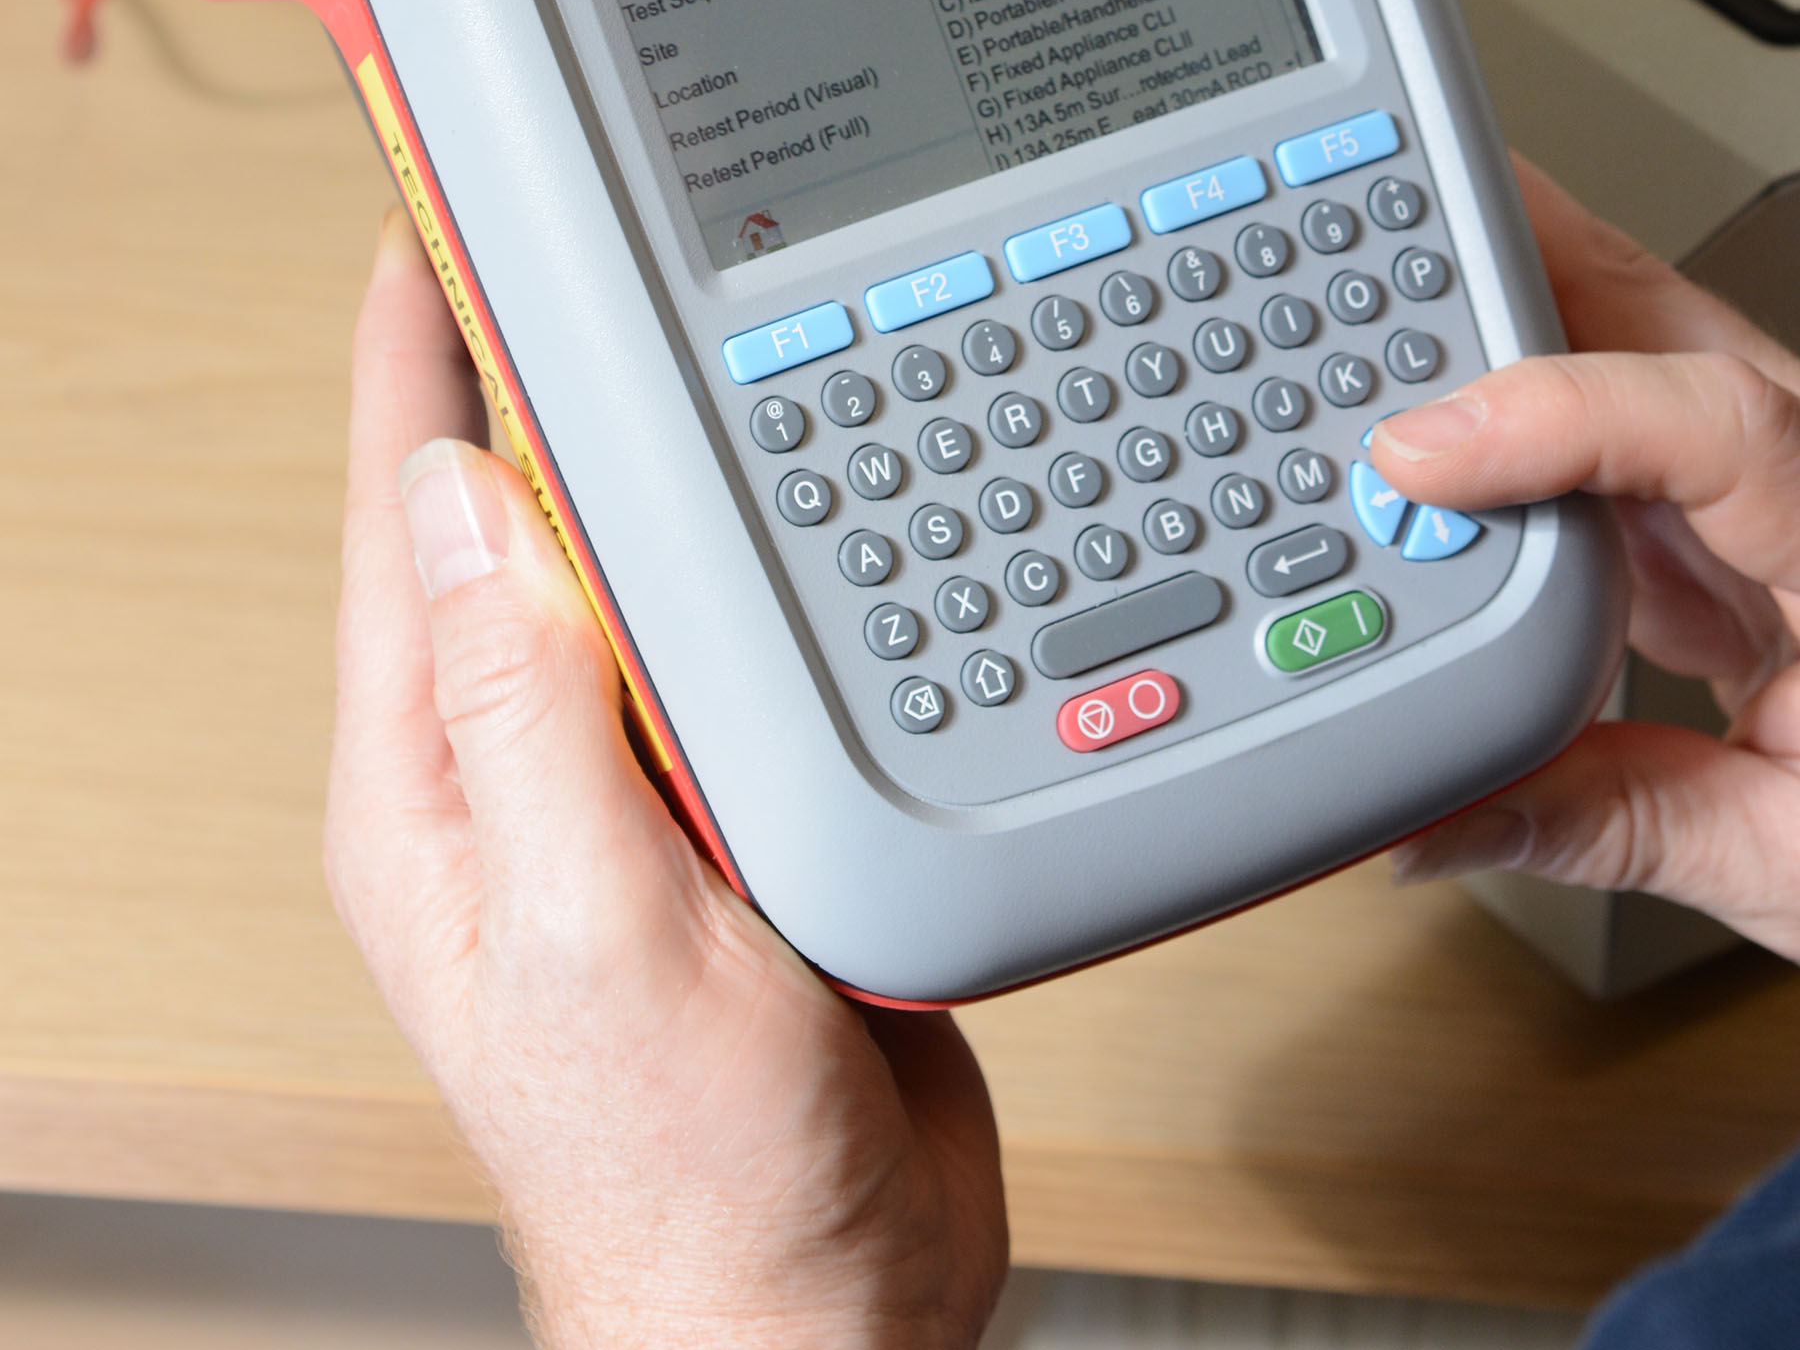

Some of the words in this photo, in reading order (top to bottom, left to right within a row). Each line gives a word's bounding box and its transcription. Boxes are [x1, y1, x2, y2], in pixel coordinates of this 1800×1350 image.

[639, 41, 679, 66] Site
[947, 17, 974, 39] D)
[957, 44, 982, 66] E)
[966, 71, 990, 93] F)
[991, 52, 1045, 84] Fixed
[1049, 23, 1140, 65] Appliance
[1142, 7, 1176, 31] CLI
[977, 97, 1002, 118] G)
[1003, 77, 1057, 109] Fixed
[1060, 49, 1152, 90] Appliance
[1154, 29, 1194, 57] CLII
[654, 70, 738, 109] Location
[669, 117, 735, 150] Retest
[736, 92, 800, 129] Period
[804, 66, 879, 109] (Visual)
[986, 123, 1012, 145] H)
[1014, 109, 1053, 135] 13A
[1054, 101, 1085, 122] 5m
[1214, 35, 1262, 66] Lead
[1014, 139, 1051, 163] 13A
[1052, 127, 1095, 150] 25m
[1171, 78, 1227, 110] 30mA
[1227, 61, 1272, 89] RCD
[685, 159, 750, 193] Retest
[751, 134, 815, 170] Period
[819, 115, 870, 150] (Full)
[392, 132, 512, 437] TECHNICAL
[771, 322, 808, 358] F1
[911, 273, 952, 307] F2
[1050, 223, 1089, 258] F3
[1185, 175, 1224, 210] F4
[1320, 128, 1359, 163] F5
[767, 401, 784, 419] @
[1185, 250, 1202, 268] &
[776, 422, 789, 441] 1
[848, 397, 863, 417] 2
[917, 371, 933, 390] 3
[990, 345, 1003, 364] 4
[1057, 320, 1072, 340] 5
[1126, 295, 1141, 315] 6
[1192, 270, 1205, 292] 7
[1260, 246, 1276, 267] 8
[1326, 223, 1343, 244] 9
[1393, 199, 1408, 221] 0
[794, 481, 821, 509] Q
[859, 453, 891, 486] W
[936, 429, 960, 460] E
[1004, 404, 1032, 433] R
[1073, 377, 1093, 406] T
[1142, 352, 1163, 380] Y
[1209, 326, 1236, 357] U
[1284, 305, 1297, 332] I
[1344, 280, 1370, 309] O
[1410, 257, 1432, 287] P
[860, 543, 884, 573] A
[927, 515, 951, 544] S
[995, 490, 1021, 520] D
[1066, 463, 1086, 493] F
[1135, 438, 1163, 467] G
[1202, 411, 1230, 443] H
[1276, 387, 1293, 416] J
[1335, 362, 1363, 394] K
[1403, 342, 1428, 369] L
[882, 614, 909, 646] Z
[951, 587, 979, 619] X
[1023, 562, 1048, 591] C
[1091, 535, 1112, 565] V
[1159, 510, 1185, 541] B
[1227, 484, 1255, 515] N
[1293, 458, 1325, 491] M
